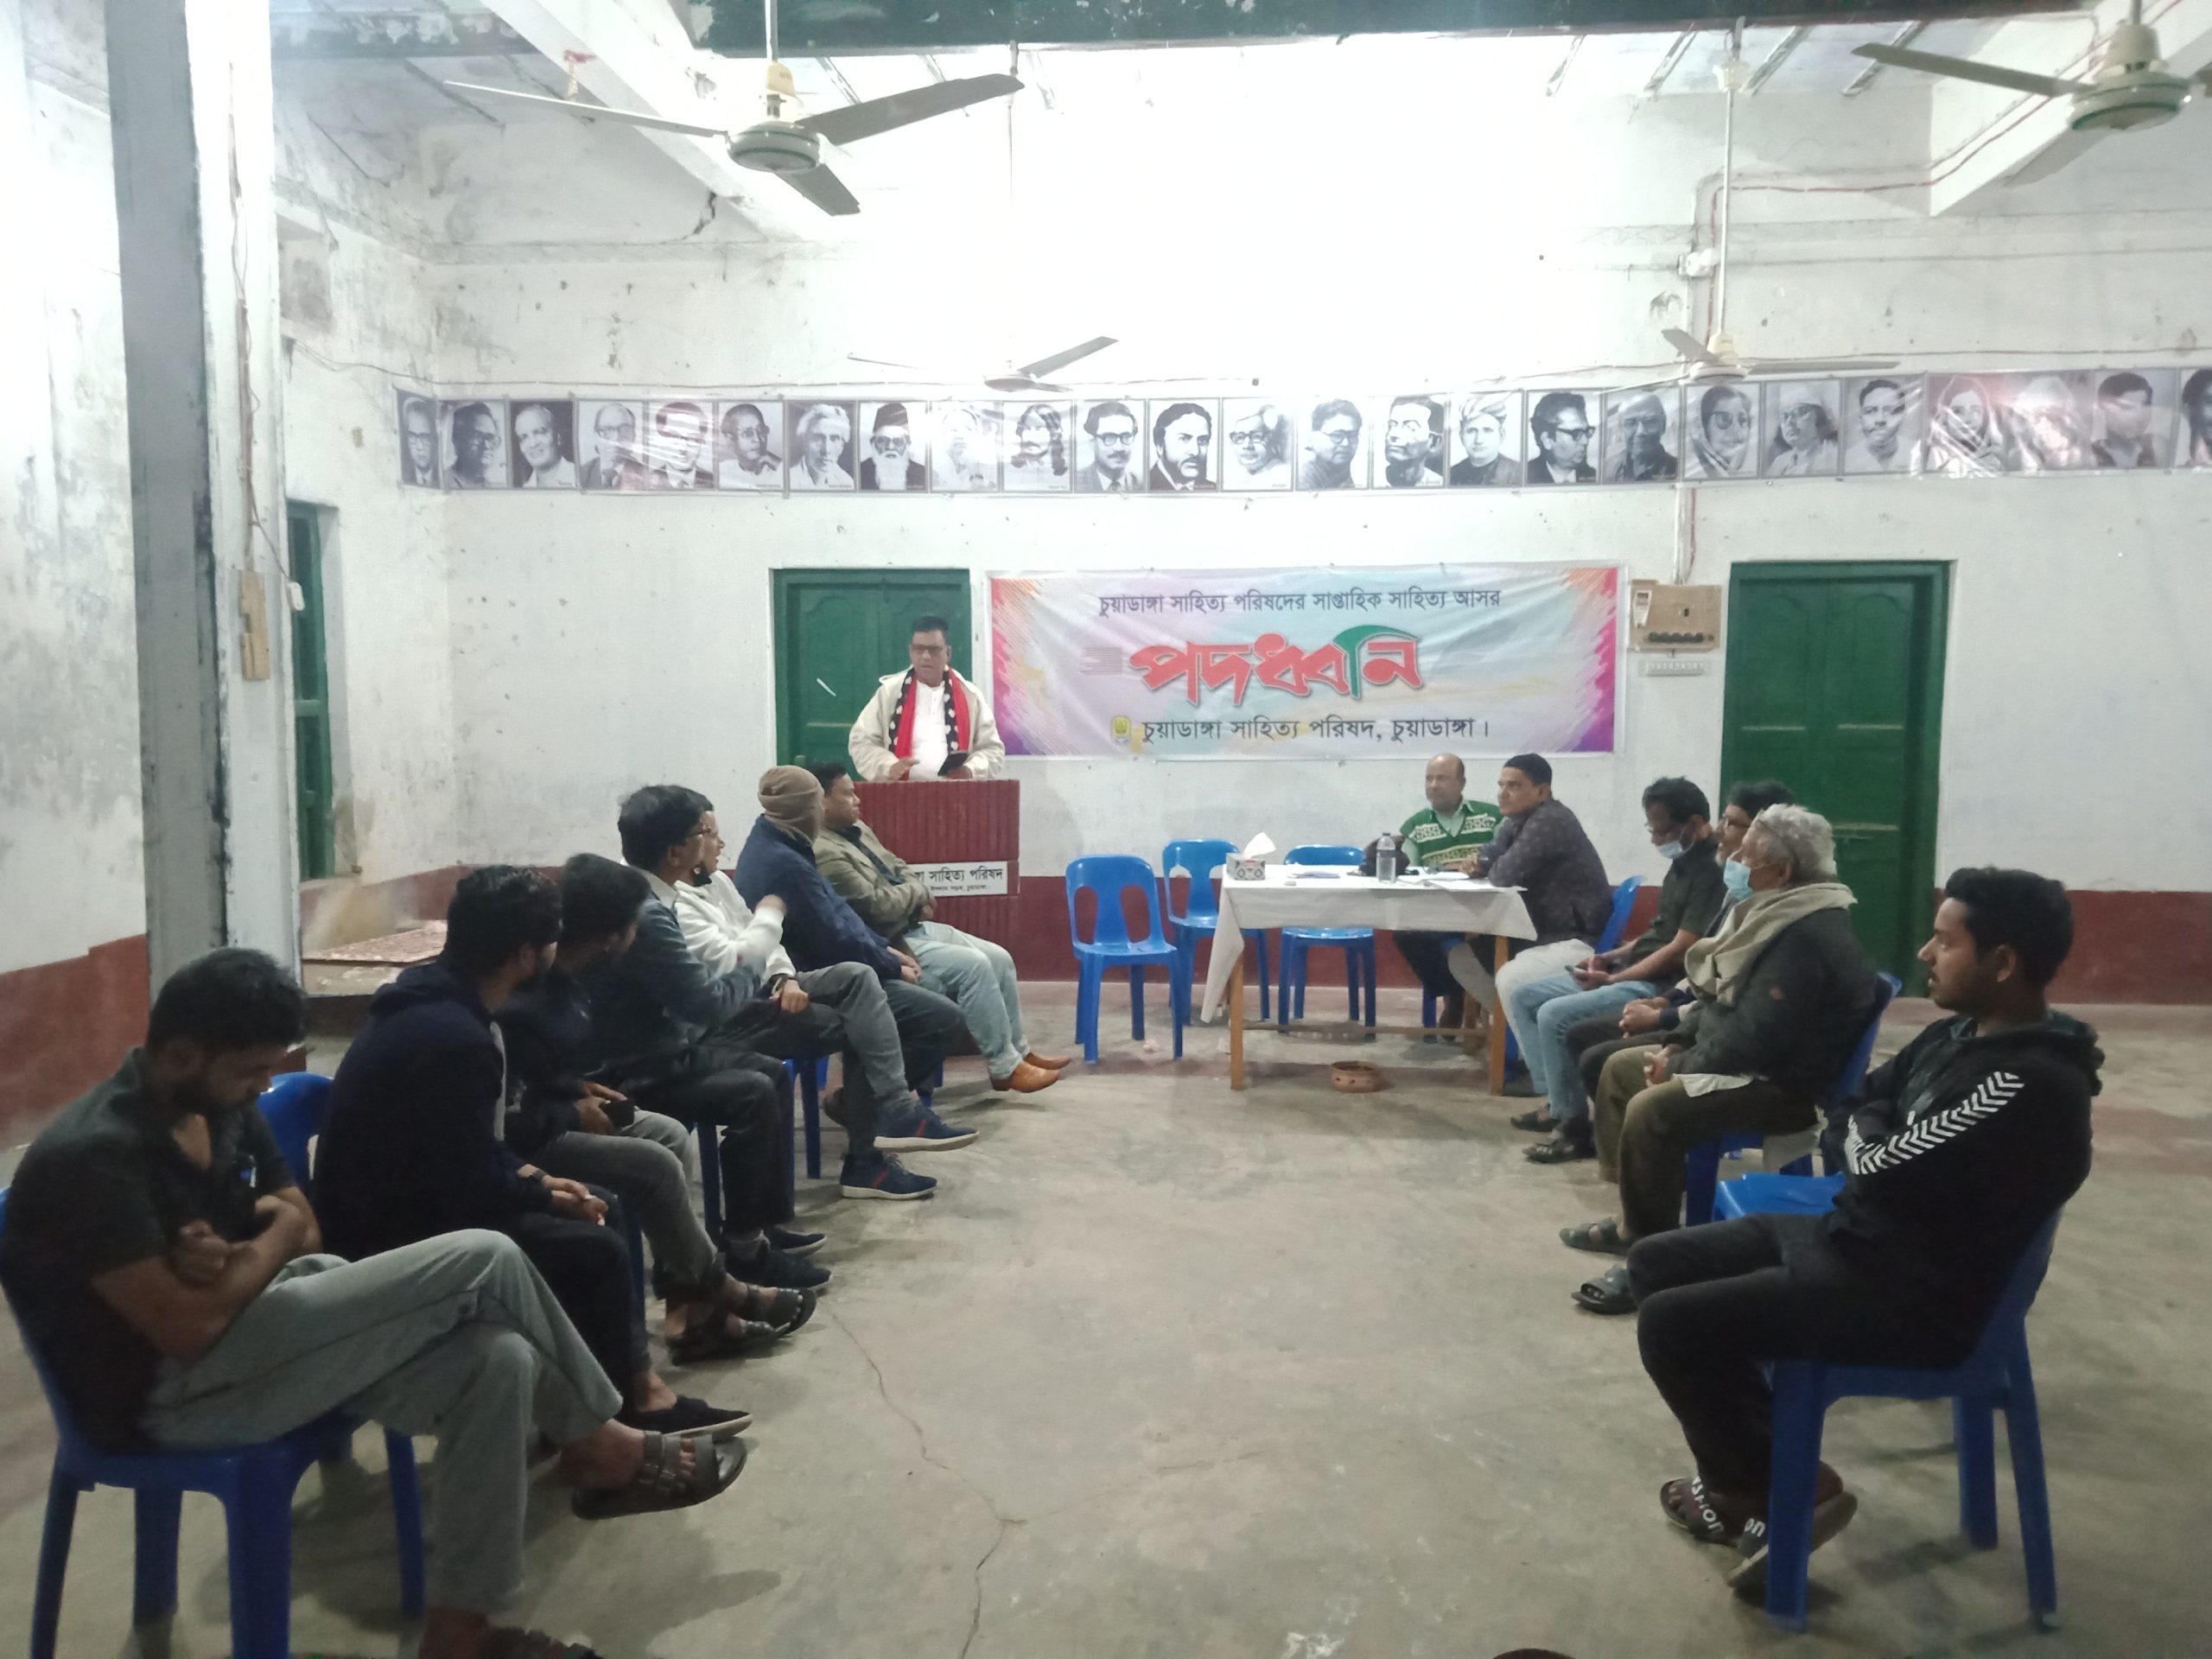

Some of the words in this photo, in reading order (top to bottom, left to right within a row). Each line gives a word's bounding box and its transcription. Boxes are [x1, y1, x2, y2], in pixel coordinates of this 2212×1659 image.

[1099, 594, 1166, 619] চুয়াডাঙ্গা
[1170, 589, 1228, 614] সাহিত্য
[1234, 588, 1307, 613] পরিষদের
[1312, 587, 1382, 612] সাপ্তাহিক
[1388, 586, 1447, 611] সাহিত্য
[1452, 588, 1502, 607] আসর
[1128, 624, 1426, 707] পদধ্বনি
[1141, 719, 1223, 745] চুয়াডাঙ্গা
[1230, 714, 1300, 740] সাহিত্য
[1309, 714, 1382, 742] পরিষদ,
[929, 867, 965, 882] সাহিত্য
[969, 865, 1003, 880] পরিষদ
